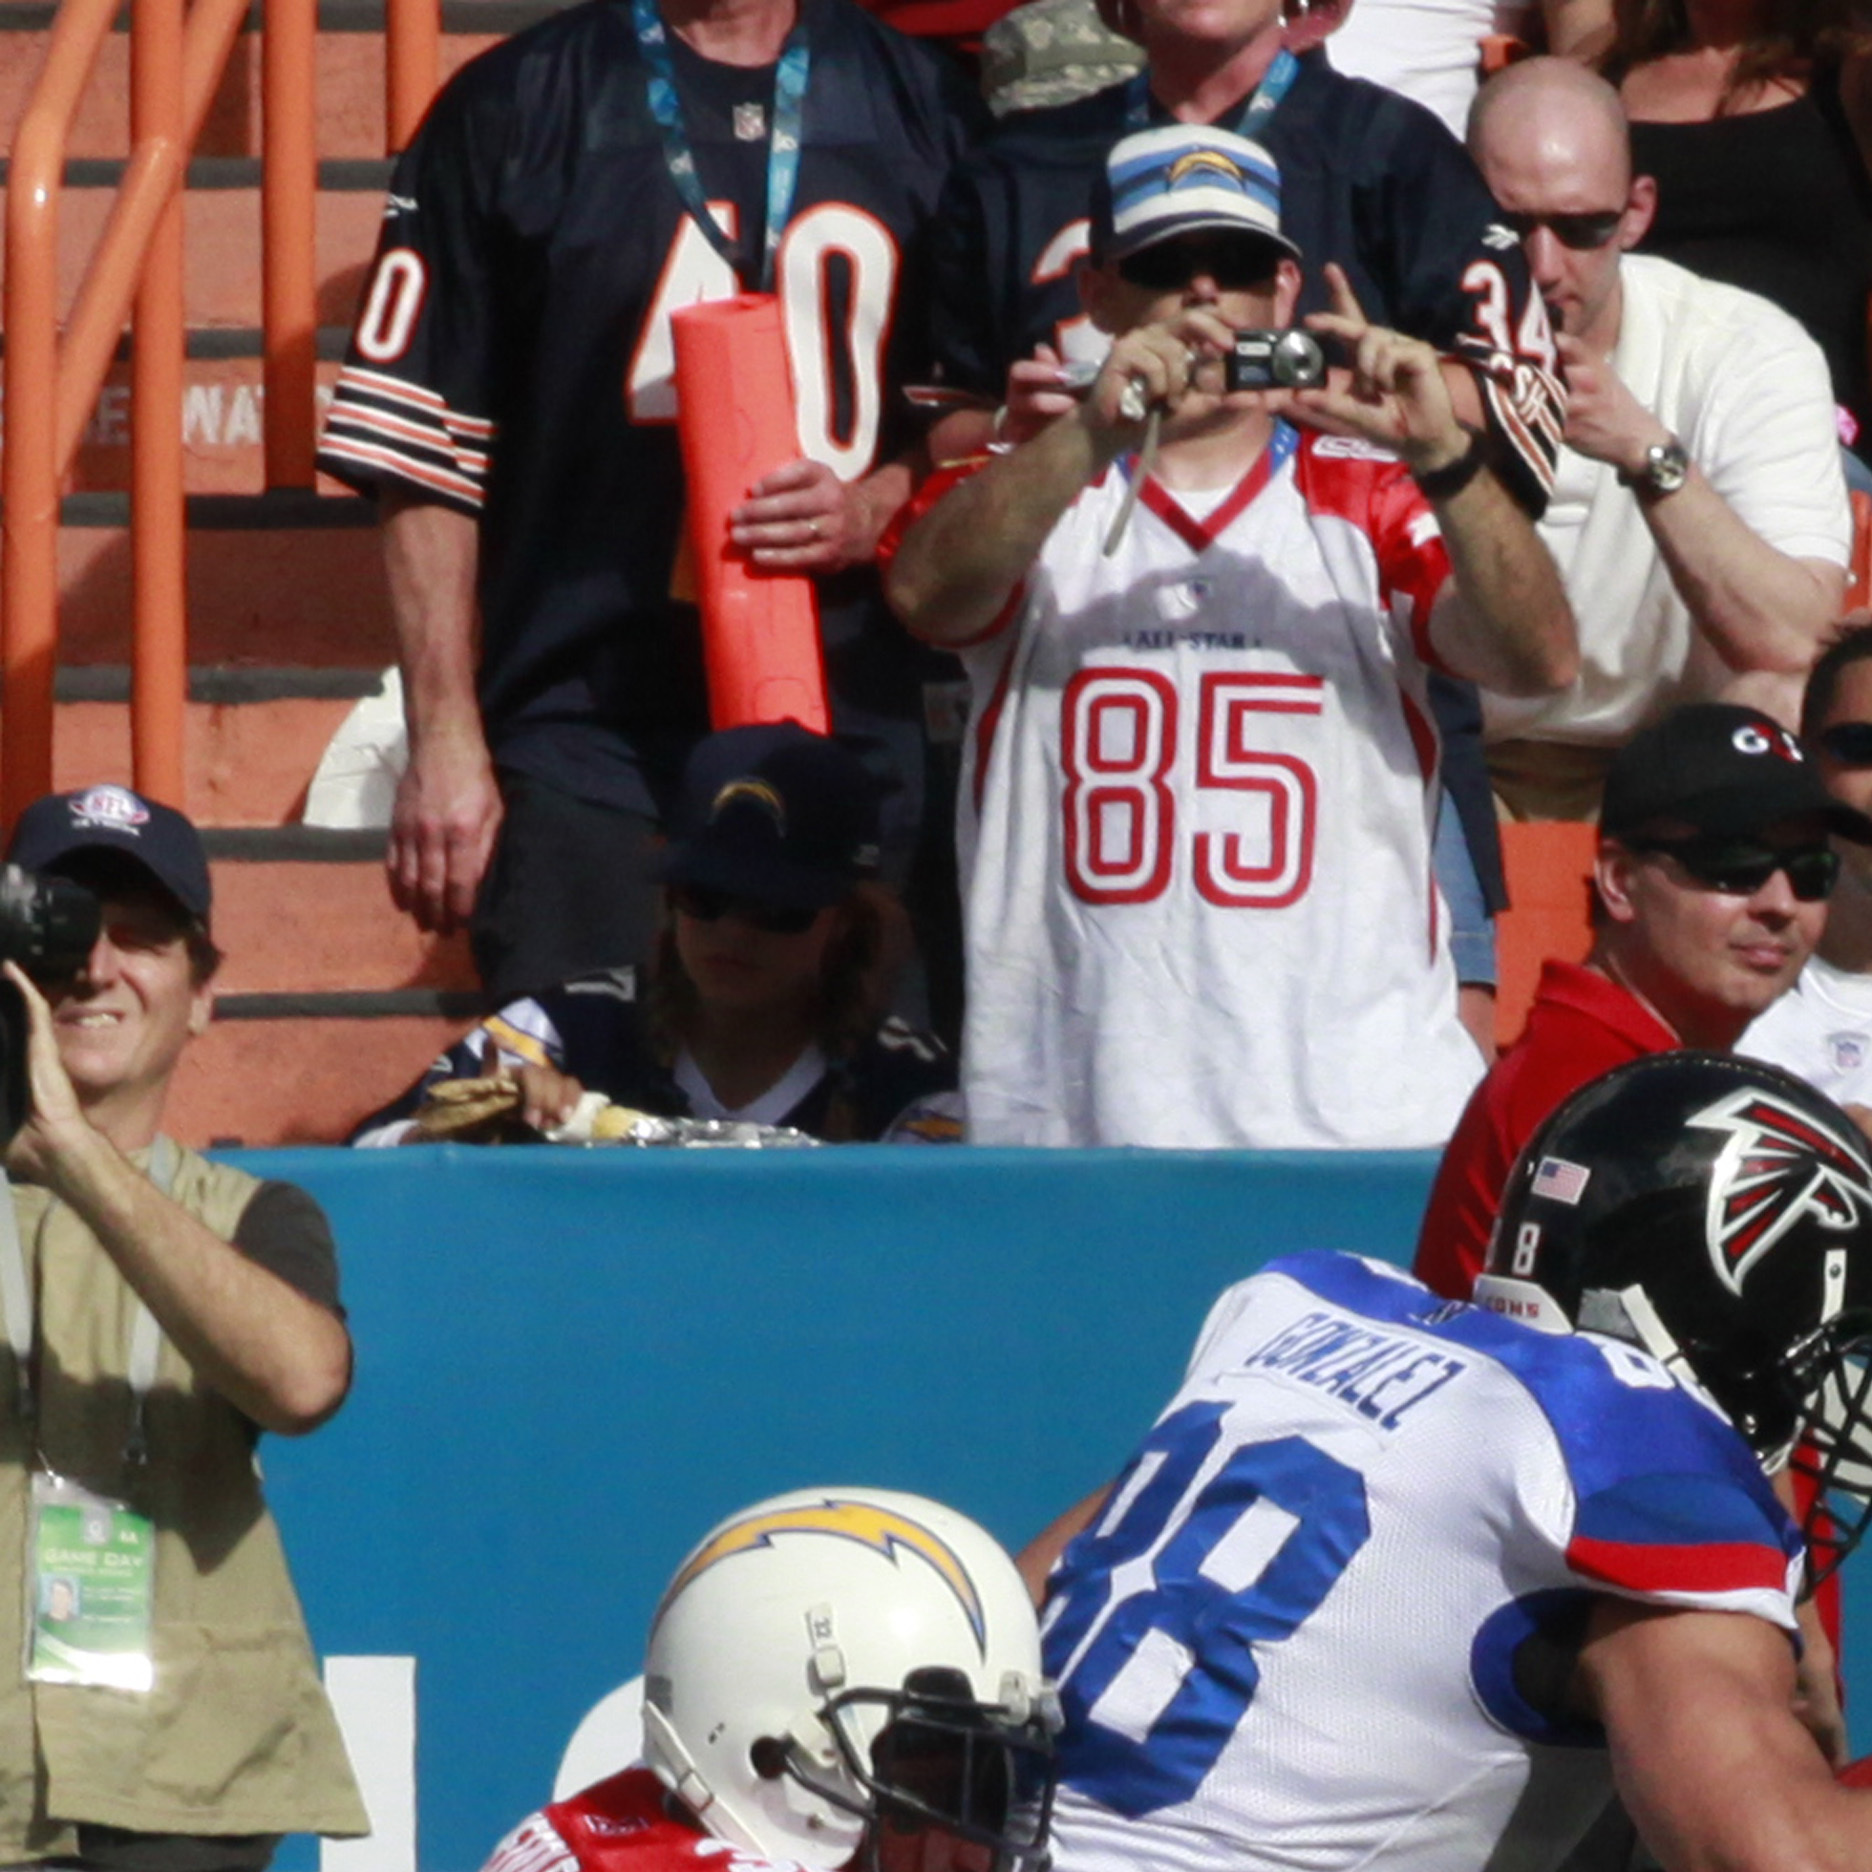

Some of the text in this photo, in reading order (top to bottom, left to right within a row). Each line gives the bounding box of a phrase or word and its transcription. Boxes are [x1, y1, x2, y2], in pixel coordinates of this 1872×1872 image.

[1062, 666, 1323, 909] 85
[1243, 1311, 1468, 1432] GONZALEZ
[1040, 1398, 1373, 1822] 88
